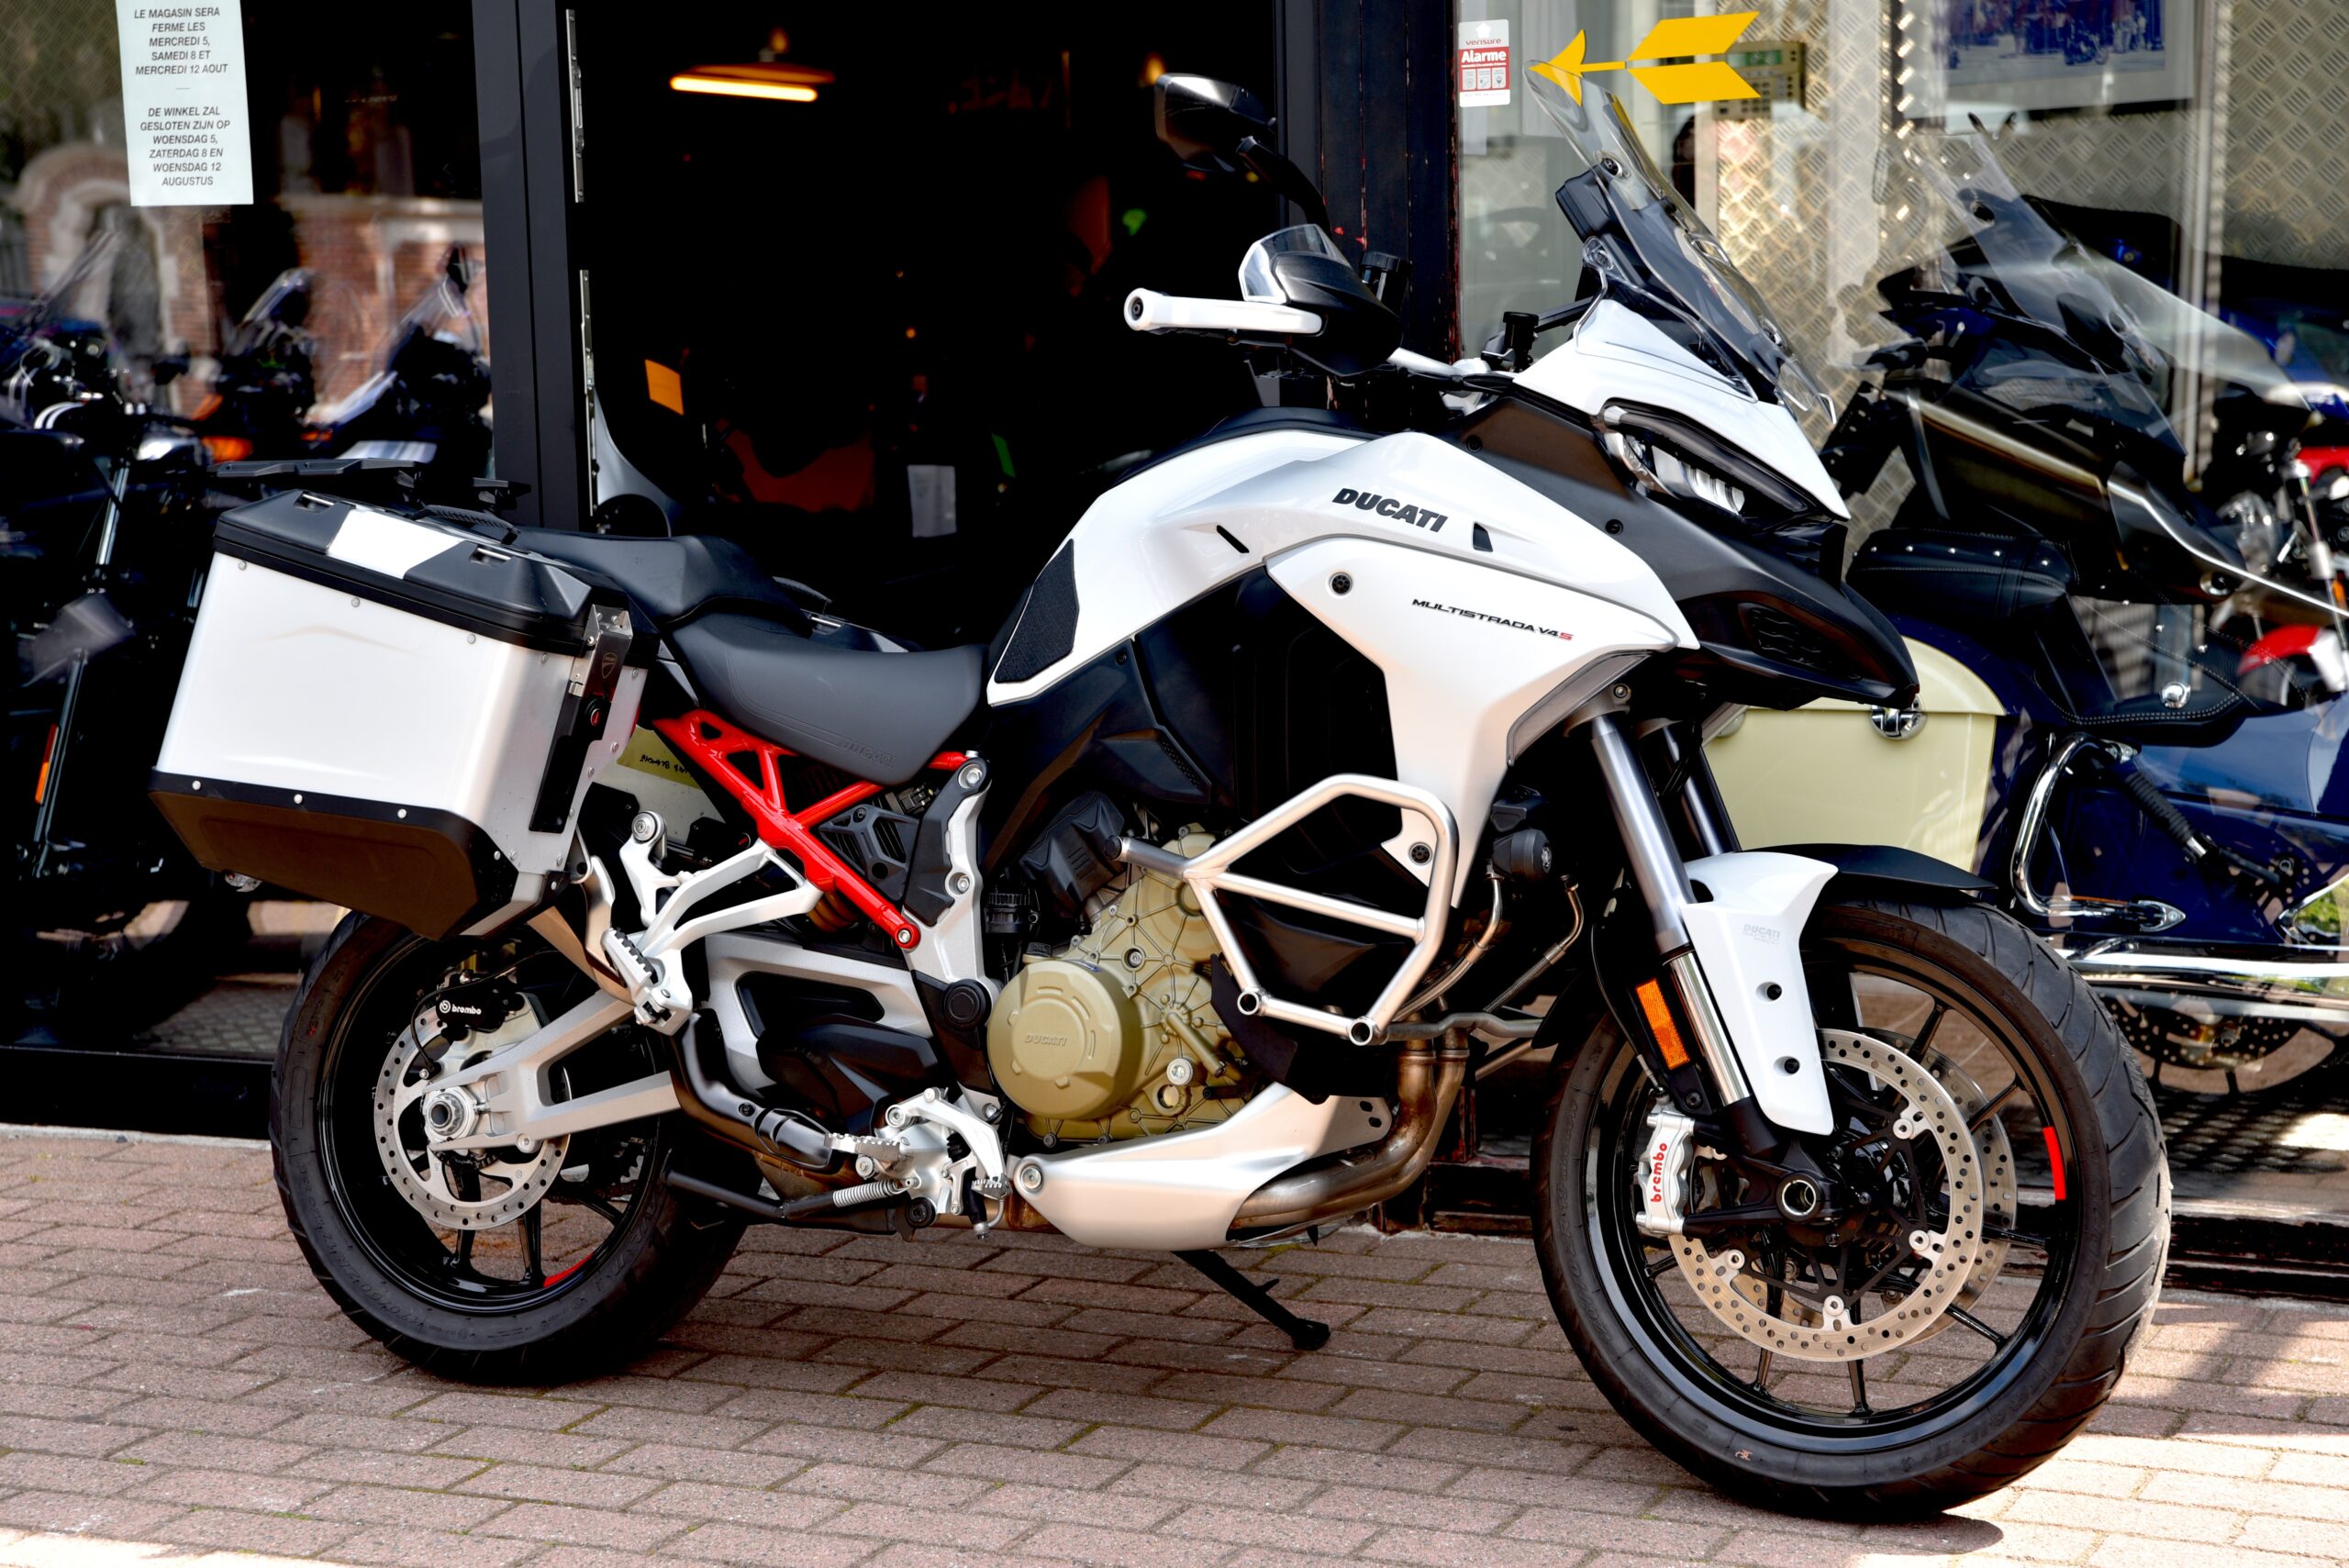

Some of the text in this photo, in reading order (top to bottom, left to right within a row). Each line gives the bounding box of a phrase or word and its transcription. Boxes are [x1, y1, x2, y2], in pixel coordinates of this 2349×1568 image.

[134, 7, 220, 18] LE MAGASIN SERA
[152, 22, 206, 33] FERME LES
[149, 37, 210, 47] MERCREDI 5,
[151, 50, 211, 61] SAMEDI 8 ET
[1461, 50, 1507, 63] Alarme
[136, 64, 228, 75] MERCREDI 12 AOUT
[148, 106, 220, 117] DE WINKEL ZAL
[140, 120, 230, 131] GESLOTEN ZIJN OP
[153, 135, 218, 145] WOENSDAG 5,
[149, 149, 223, 159] ZATERDAG 8 EN
[153, 162, 221, 172] WOENSDAG 12
[161, 176, 214, 186] AUGUSTUS
[1331, 487, 1449, 533] DUCATI
[1412, 598, 1575, 641] MULTISTRADA V4S
[1742, 923, 1781, 940] DUCATI
[451, 1005, 482, 1015] brembo
[1024, 1034, 1068, 1048] DUCATI
[1650, 1142, 1667, 1203] brembo
